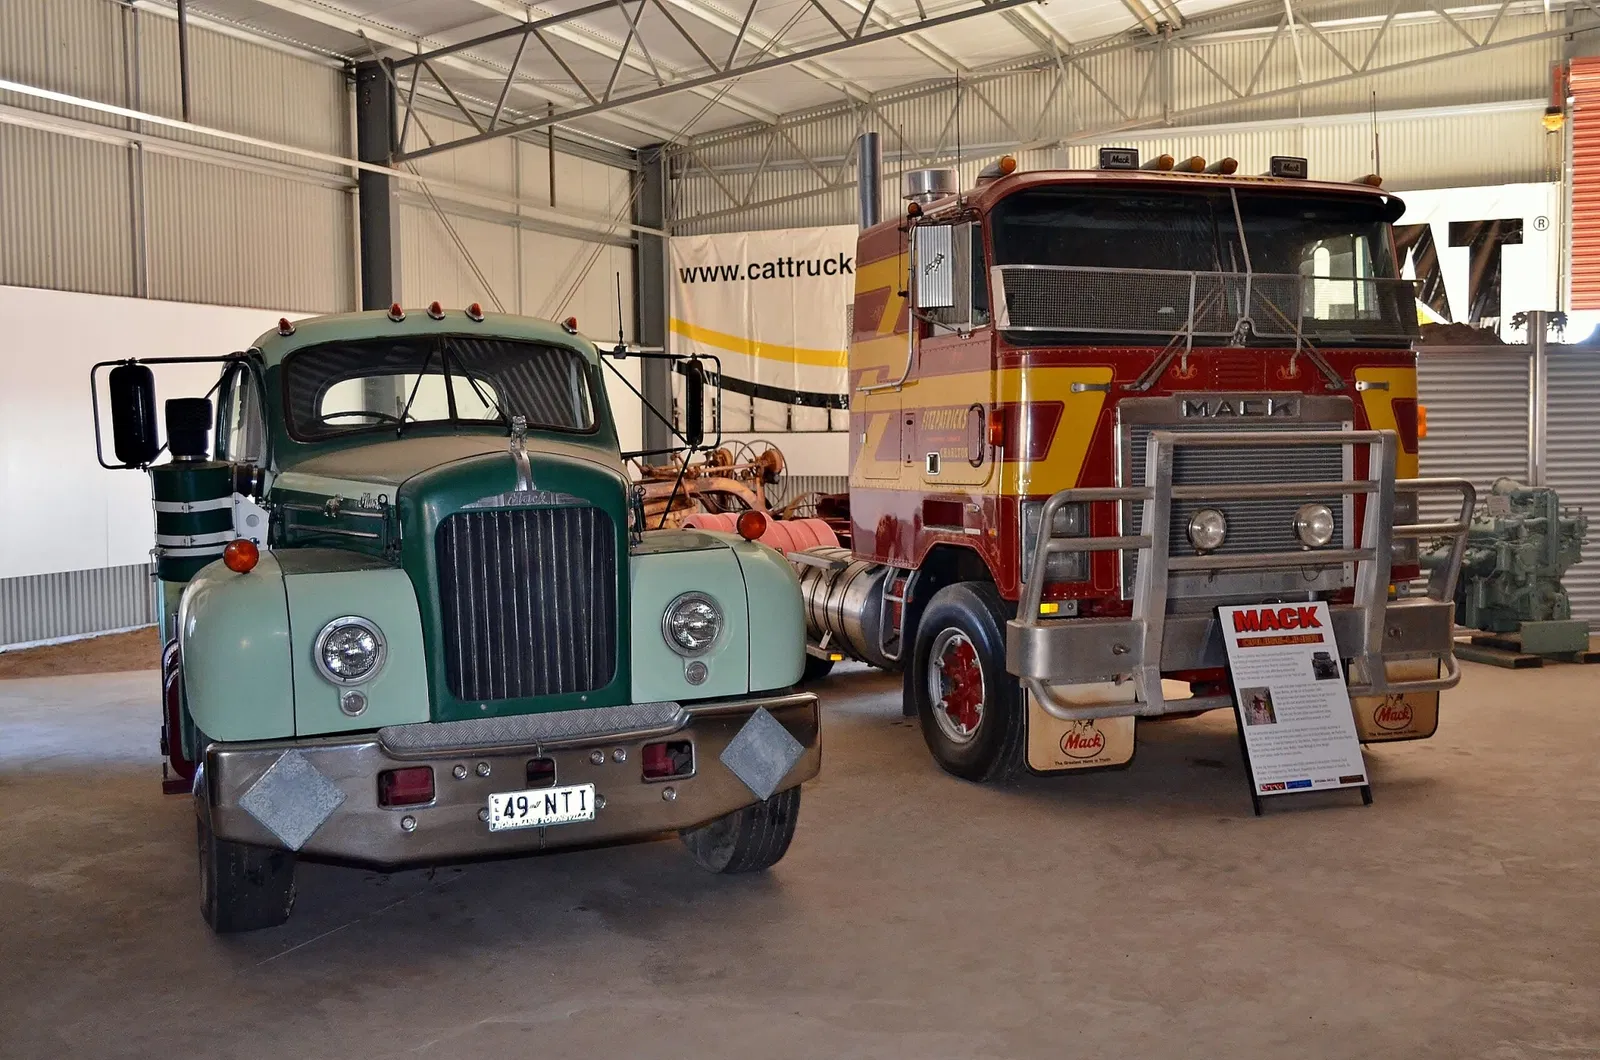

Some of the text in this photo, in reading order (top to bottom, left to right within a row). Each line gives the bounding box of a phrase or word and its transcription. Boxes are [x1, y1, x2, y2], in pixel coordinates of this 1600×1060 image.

[1110, 154, 1130, 165] Mack
[1282, 162, 1300, 172] Mack
[678, 252, 858, 284] www.cattruck
[1181, 398, 1293, 417] MACK
[1232, 605, 1323, 633] MACK
[1377, 706, 1410, 722] Mack
[1064, 732, 1102, 750] Mack
[503, 789, 586, 819] 49 NTI
